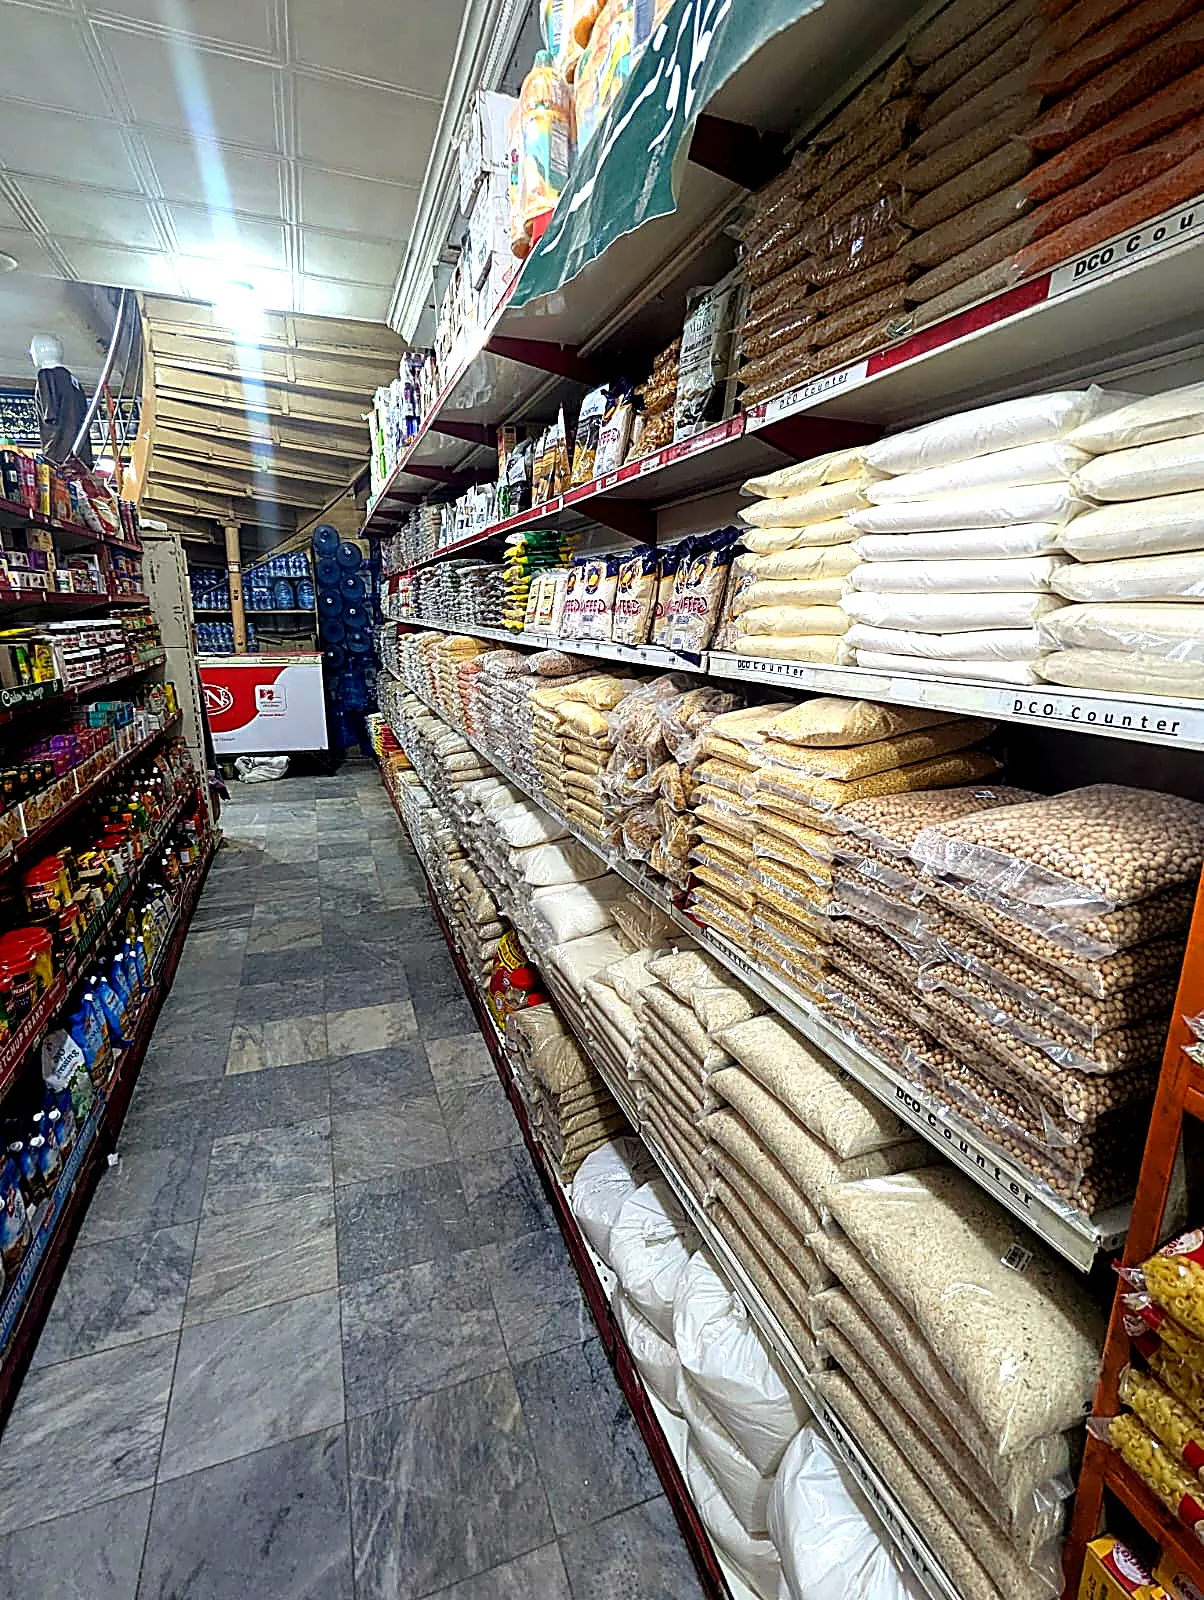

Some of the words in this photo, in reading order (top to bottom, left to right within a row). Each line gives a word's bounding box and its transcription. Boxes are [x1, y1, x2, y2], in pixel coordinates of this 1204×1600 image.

[1074, 247, 1114, 278] DCO
[803, 371, 849, 398] Counter
[737, 659, 751, 669] DCO
[753, 661, 805, 677] Counter
[1013, 699, 1054, 716] DCO
[1071, 706, 1181, 734] Counter
[896, 1086, 921, 1113] DCO
[927, 1112, 1033, 1206] Counter
